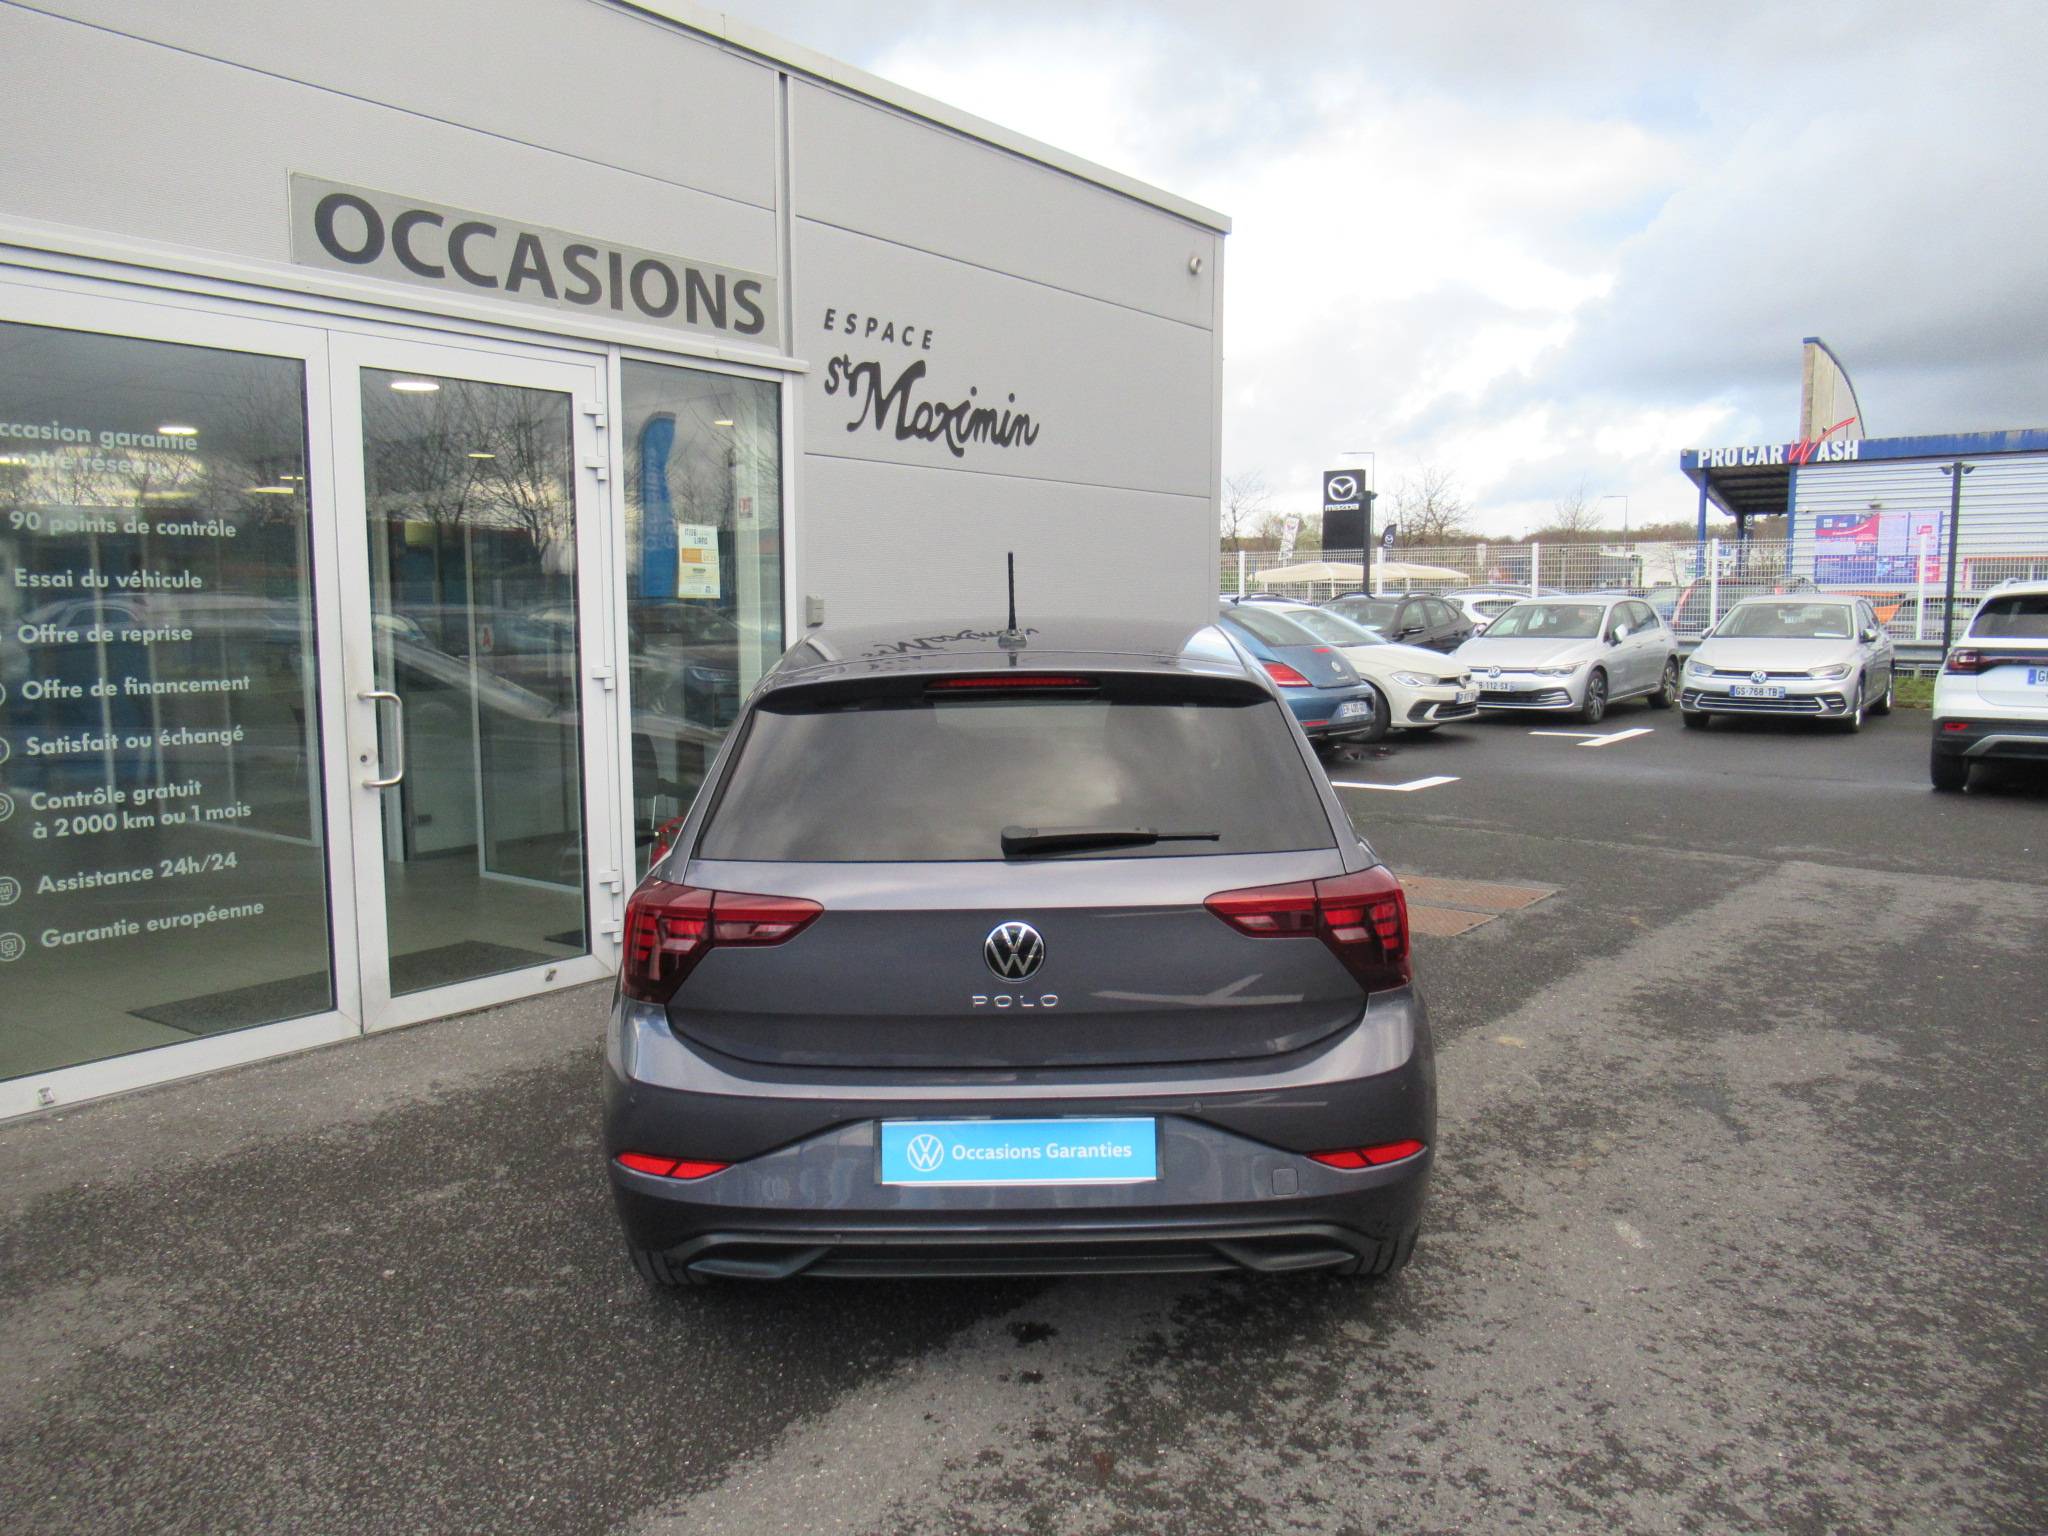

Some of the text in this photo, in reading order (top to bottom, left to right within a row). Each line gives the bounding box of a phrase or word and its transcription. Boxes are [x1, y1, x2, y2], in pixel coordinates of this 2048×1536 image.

[314, 193, 765, 335] OCCASIONS
[823, 308, 933, 350] ESPACE
[847, 360, 1040, 458] Maximin
[0, 421, 198, 450] ccasion garantie
[1698, 447, 1738, 468] PRO
[1742, 444, 1784, 466] CAR
[9, 511, 237, 537] 90 points de contrôle
[15, 569, 202, 588] Essai du véhicule
[17, 624, 193, 645] Offre de reprise
[22, 676, 251, 700] Offre de financement
[26, 725, 244, 756] Satisfait ou échangé
[31, 780, 202, 811] Contrôle gratuit
[33, 822, 47, 839] à
[123, 811, 155, 830] km
[161, 810, 186, 825] ou
[191, 805, 201, 822] 1
[205, 801, 252, 821] mois
[36, 852, 238, 894] Assistance 24h/24
[41, 902, 265, 948] Garantie européenne
[971, 994, 1059, 1008] POLO
[951, 1143, 1042, 1160] Occasions
[1045, 1141, 1133, 1159] Garanties
